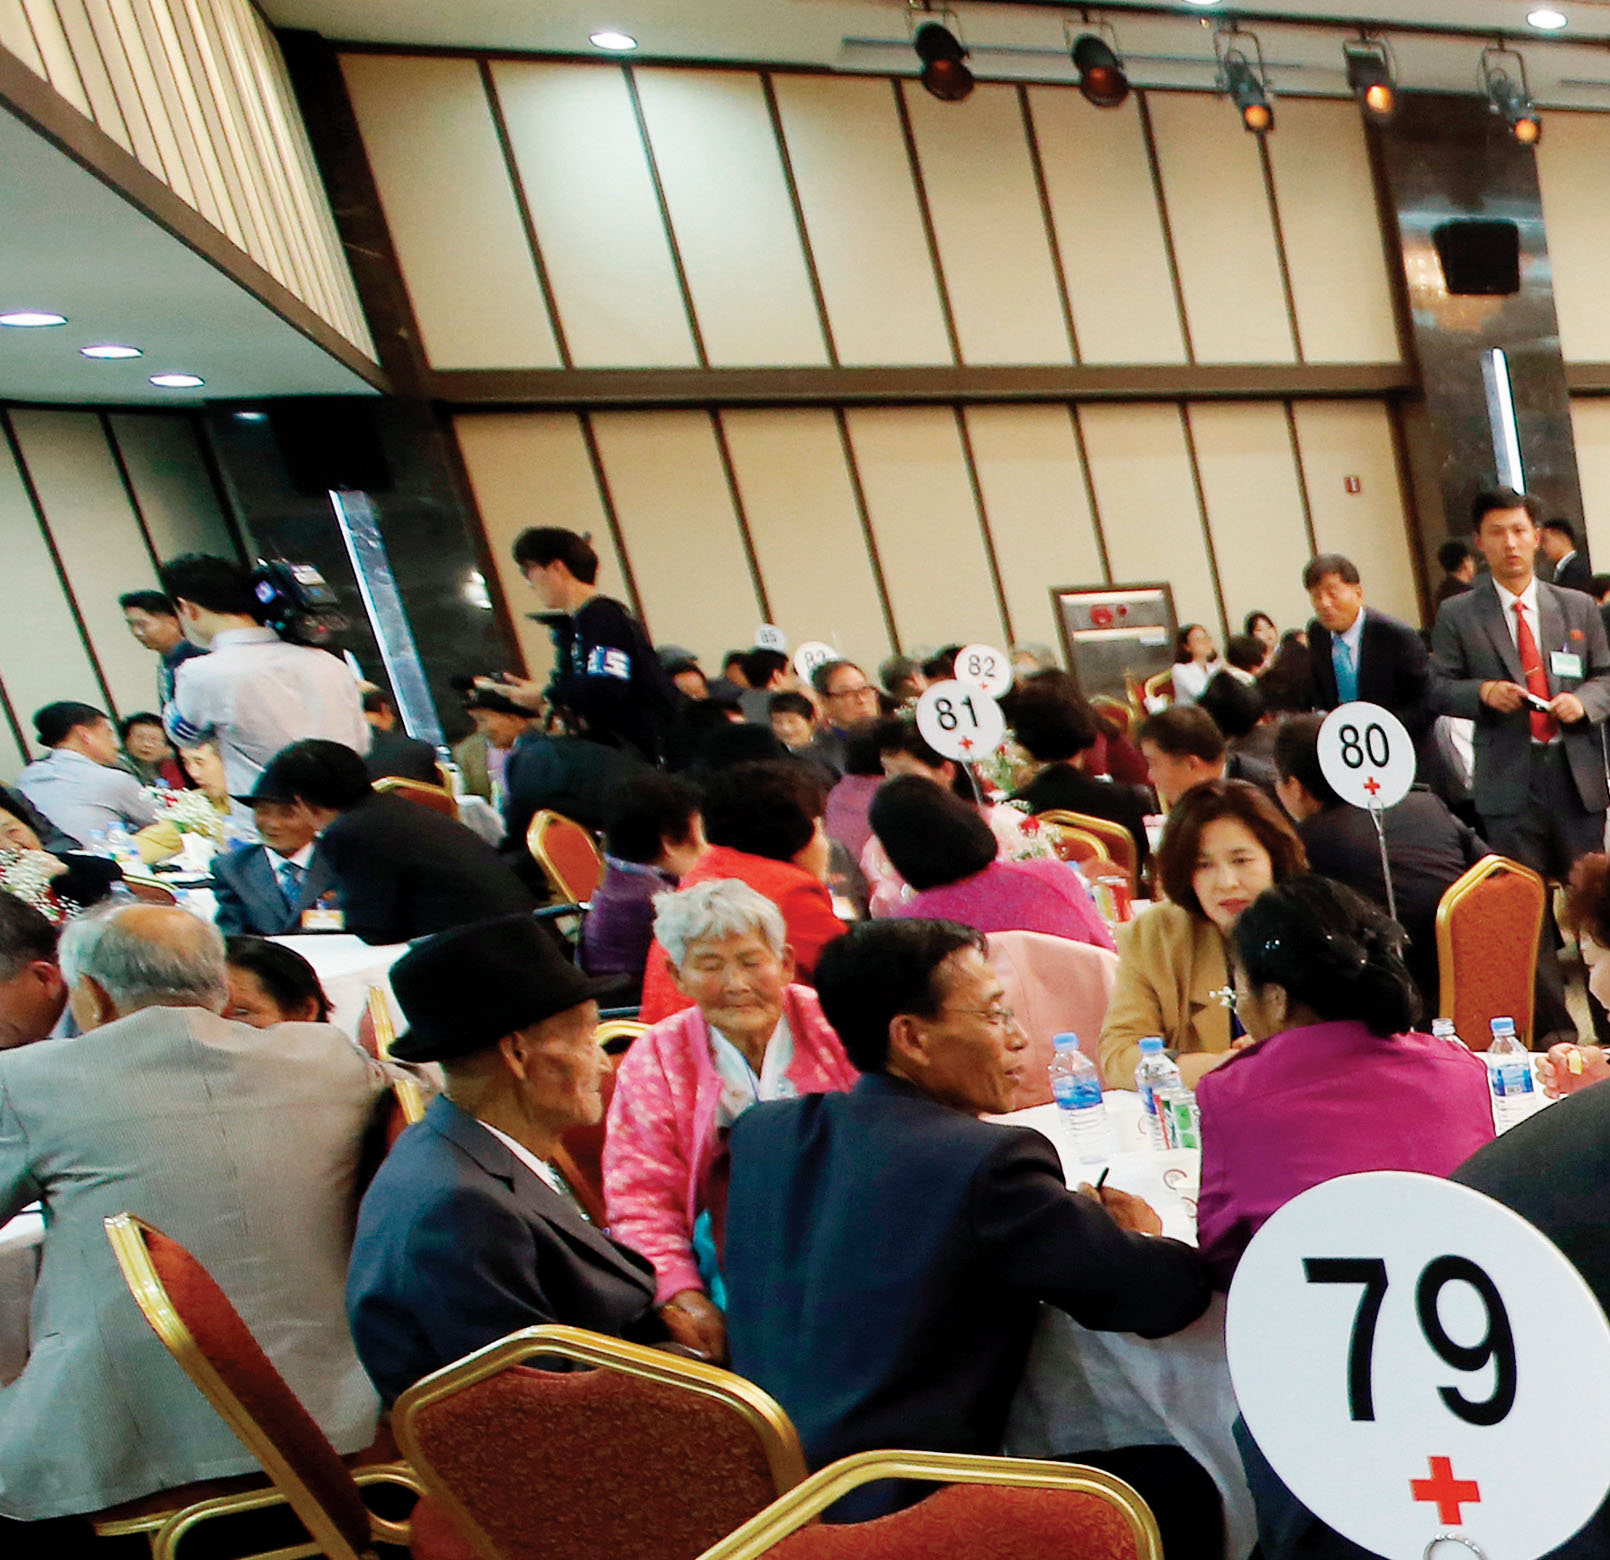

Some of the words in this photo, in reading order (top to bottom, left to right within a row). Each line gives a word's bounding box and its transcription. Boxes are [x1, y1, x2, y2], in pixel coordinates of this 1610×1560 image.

[968, 654, 996, 677] 82
[934, 696, 978, 731] 81
[1339, 722, 1390, 769] 80
[1302, 1254, 1519, 1427] 79
